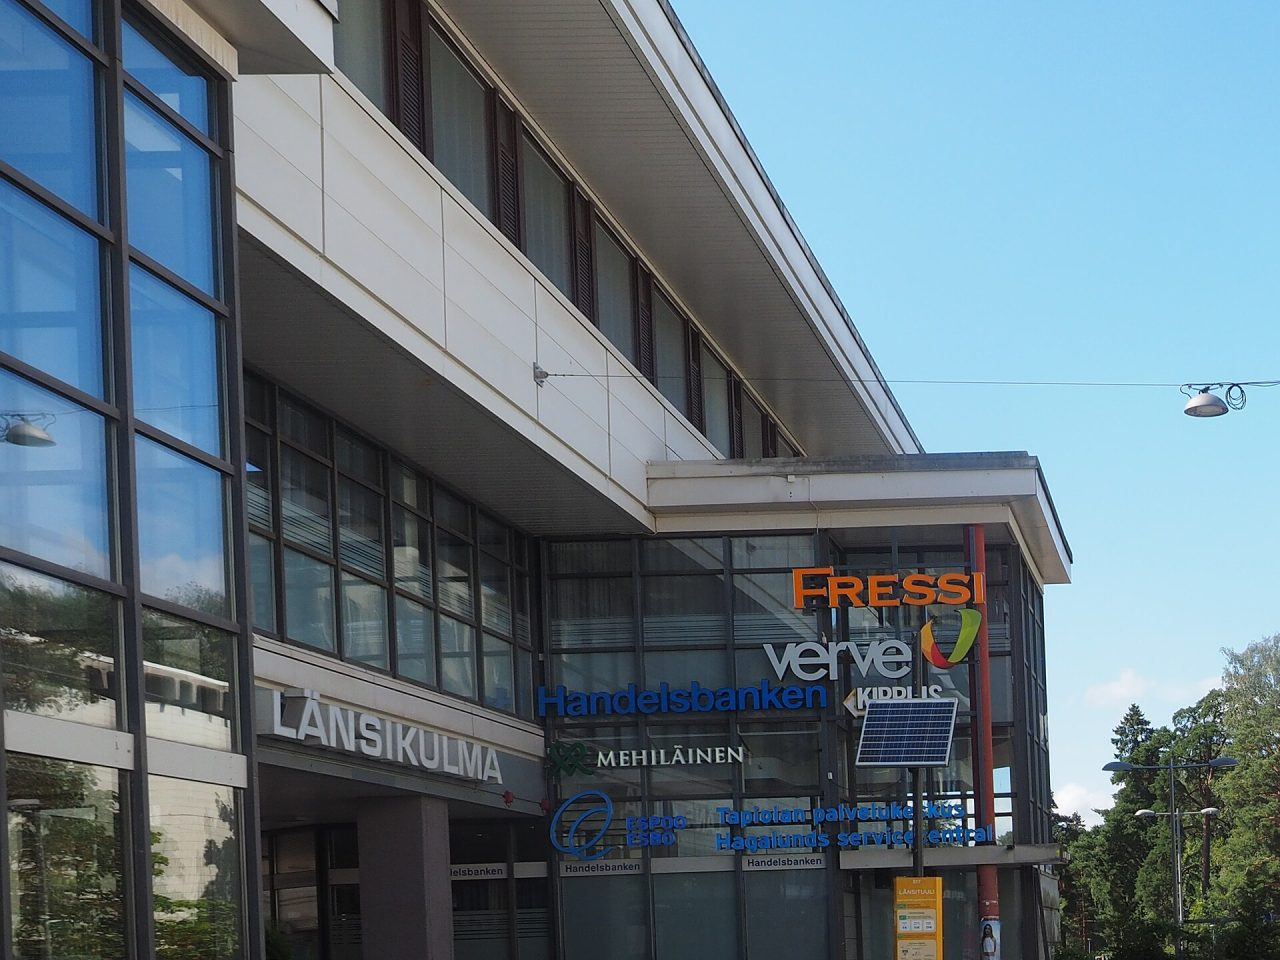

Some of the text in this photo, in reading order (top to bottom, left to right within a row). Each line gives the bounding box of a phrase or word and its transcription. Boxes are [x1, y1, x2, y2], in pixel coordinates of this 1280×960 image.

[792, 566, 986, 609] FRESSI
[762, 639, 913, 681] verve
[538, 679, 827, 717] Handelsbanken
[273, 690, 503, 785] LÄNSIKULMA
[596, 745, 744, 768] MEHILÄINEN
[625, 815, 688, 830] ESPOO
[715, 804, 805, 827] Tapiolan
[715, 824, 993, 853] Hagalunds serviceentral
[449, 867, 503, 877] elsbanken
[565, 862, 641, 874] Handelsbanken
[747, 856, 822, 868] Handelsbanken
